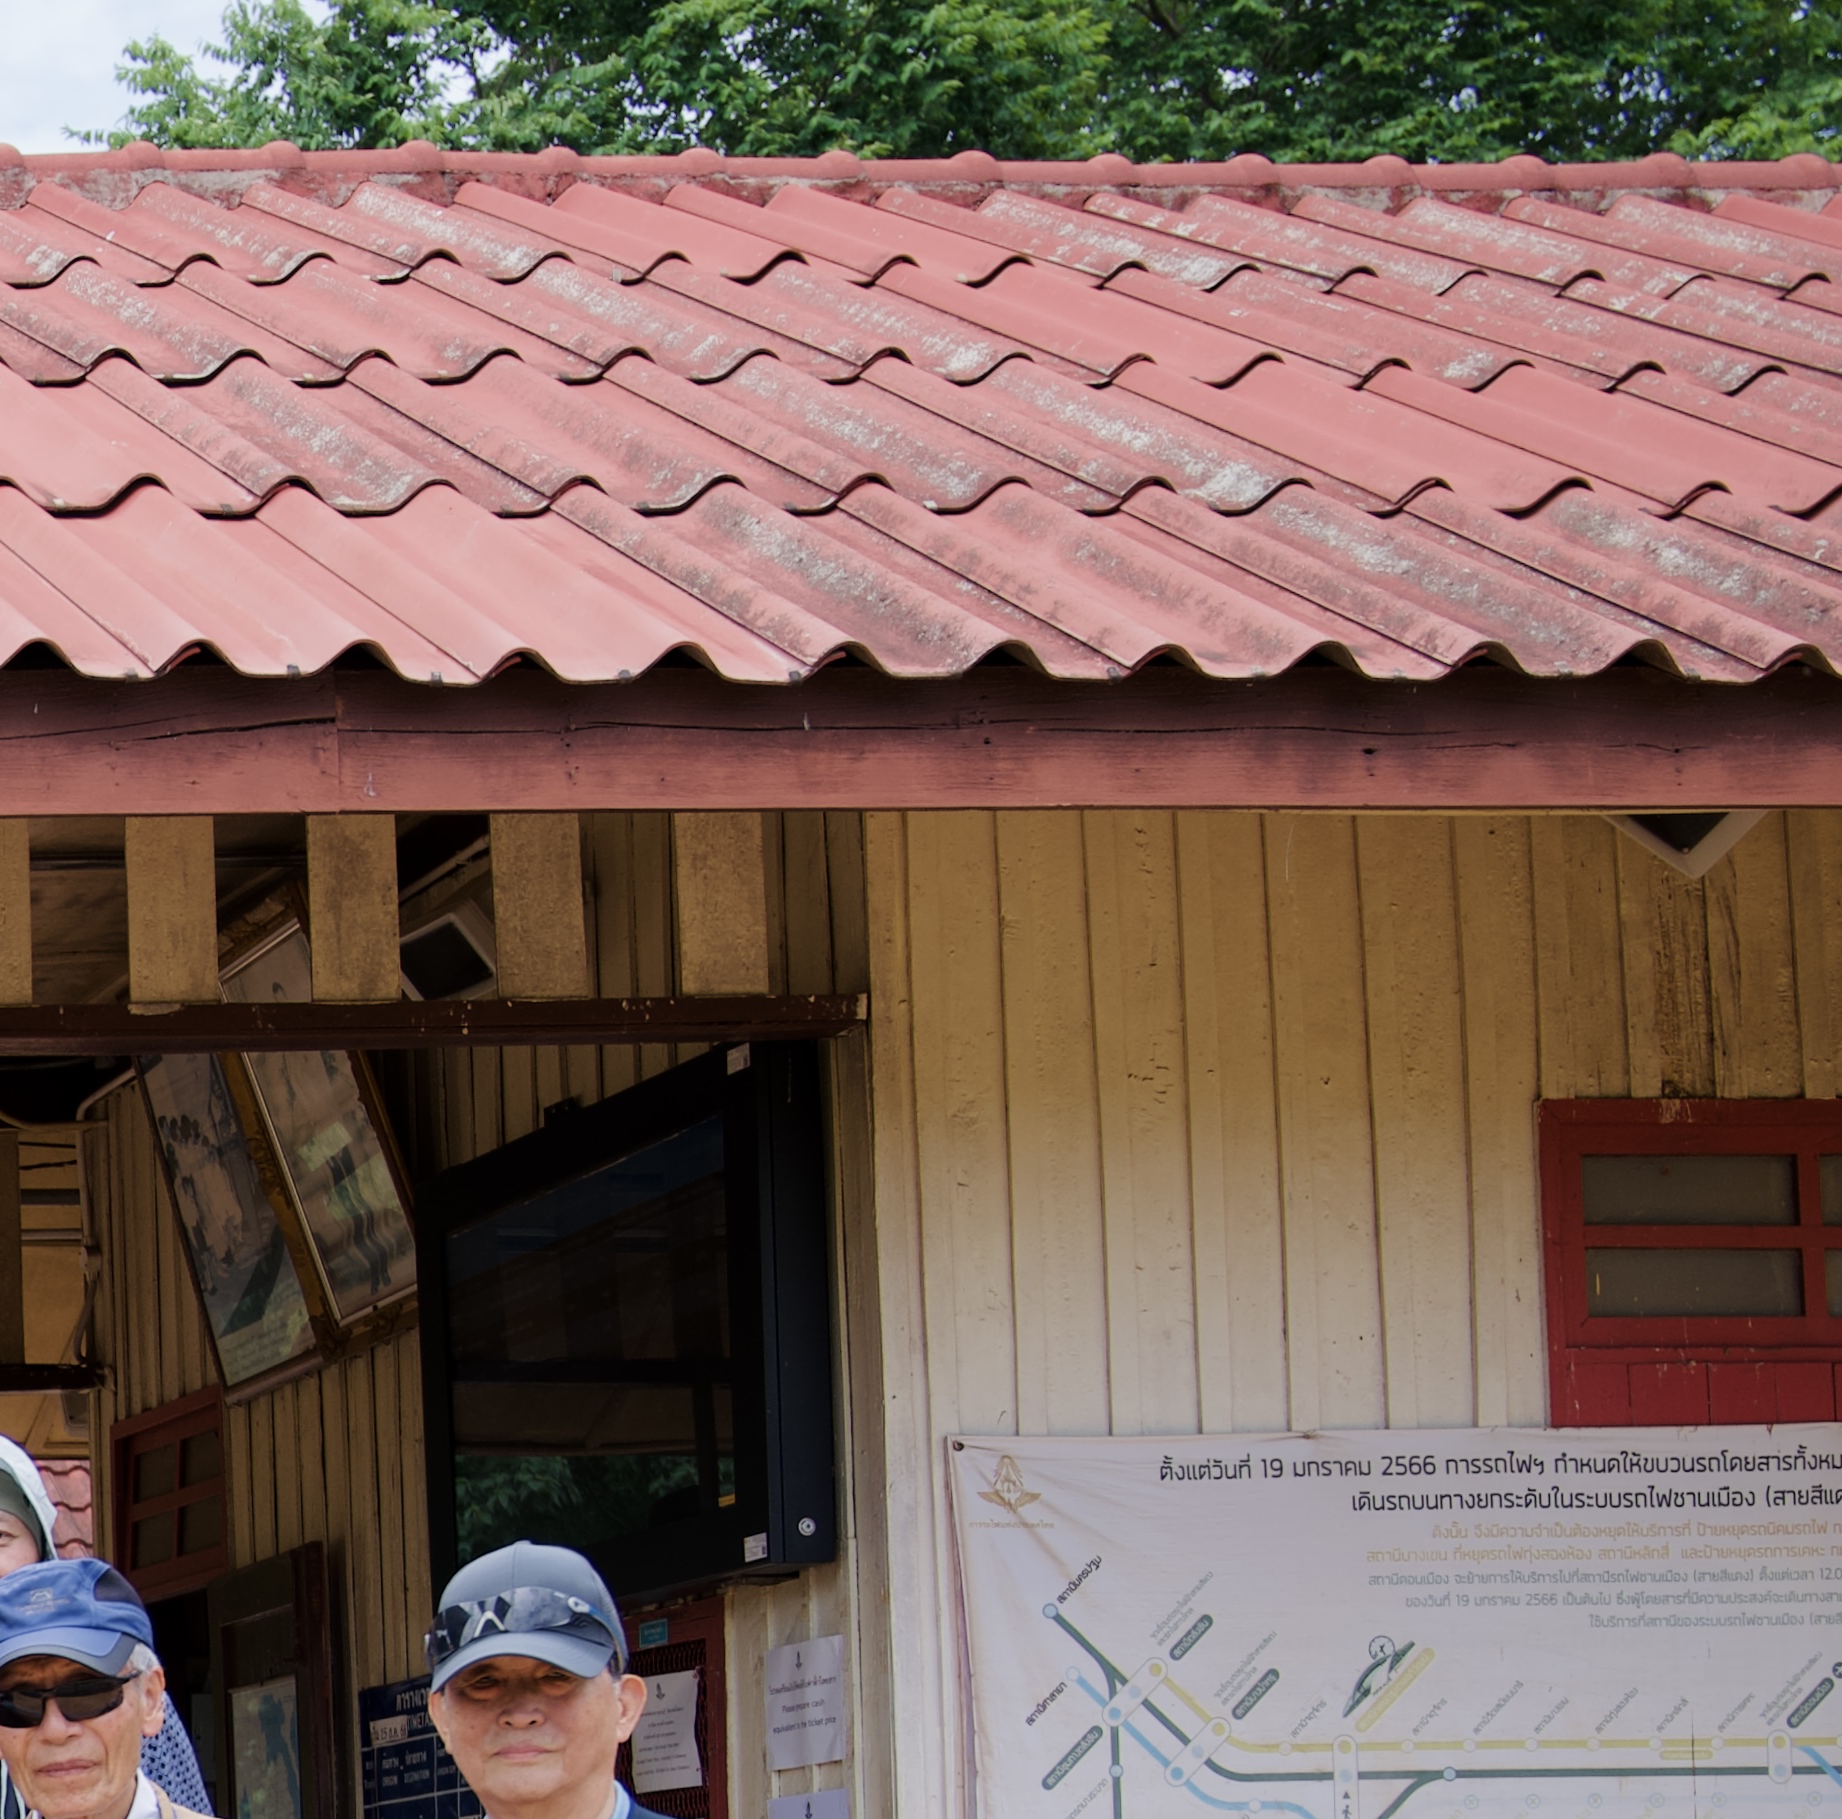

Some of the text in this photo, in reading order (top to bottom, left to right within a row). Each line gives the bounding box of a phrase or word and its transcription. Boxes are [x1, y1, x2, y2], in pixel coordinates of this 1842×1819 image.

[1159, 1454, 1252, 1482] ตั้งแต่วันที่
[1261, 1457, 1285, 1479] 19
[1292, 1457, 1373, 1478] มกราคม
[1380, 1454, 1437, 1477] 2566
[1444, 1449, 1546, 1479] การรถไฟฯ
[1351, 1485, 1756, 1513] เดินรถบนทางยกระดับในระบบรถไฟชานเมือง
[1454, 1593, 1471, 1607] 19
[1524, 1592, 1559, 1607] 2566
